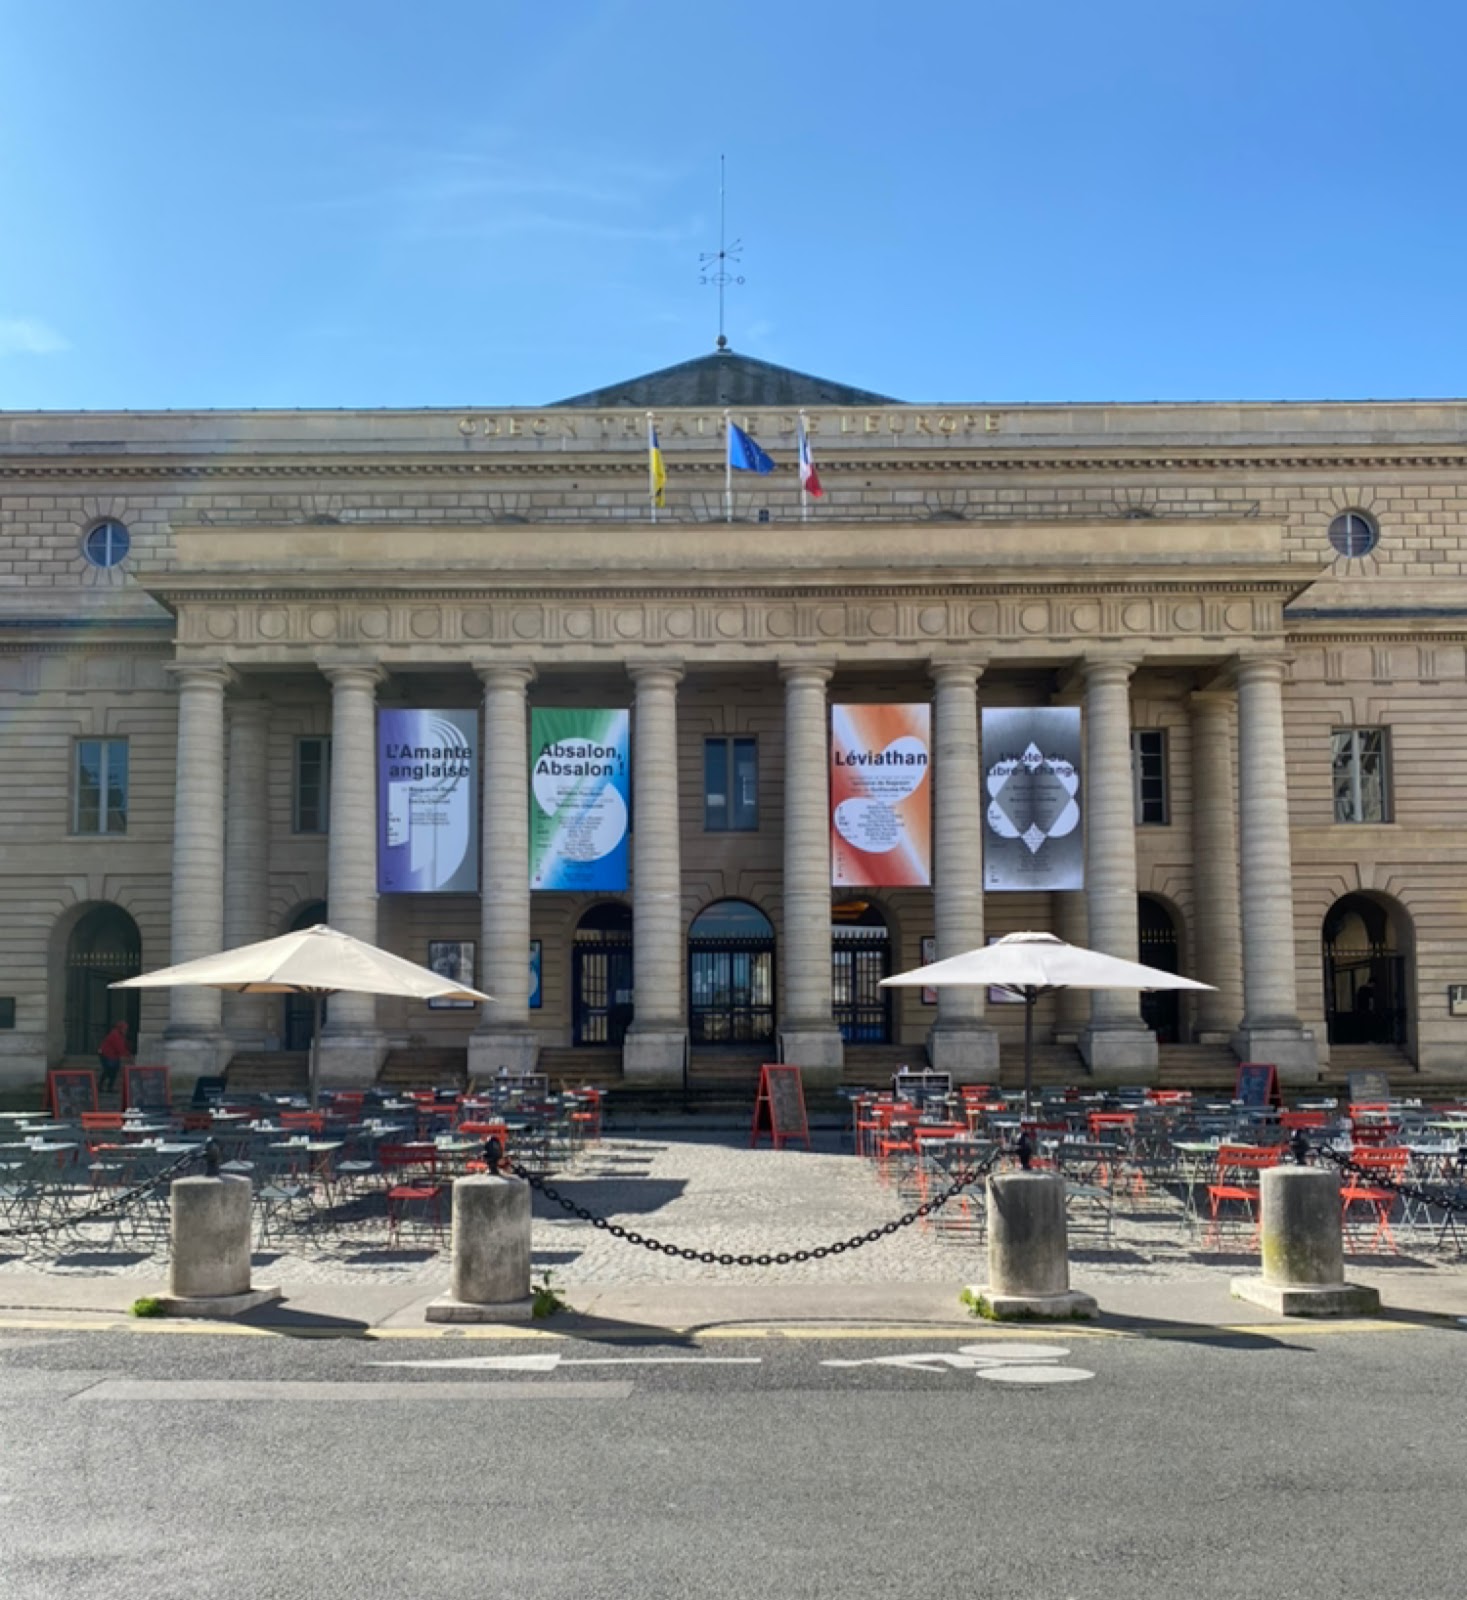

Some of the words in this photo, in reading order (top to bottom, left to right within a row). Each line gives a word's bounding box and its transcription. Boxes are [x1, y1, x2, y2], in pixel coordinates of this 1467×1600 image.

[386, 743, 472, 759] L'Amante
[539, 743, 622, 761] Absalon,
[835, 750, 928, 766] Léviathan
[389, 763, 470, 780] anglaise
[537, 761, 614, 776] Absalon
